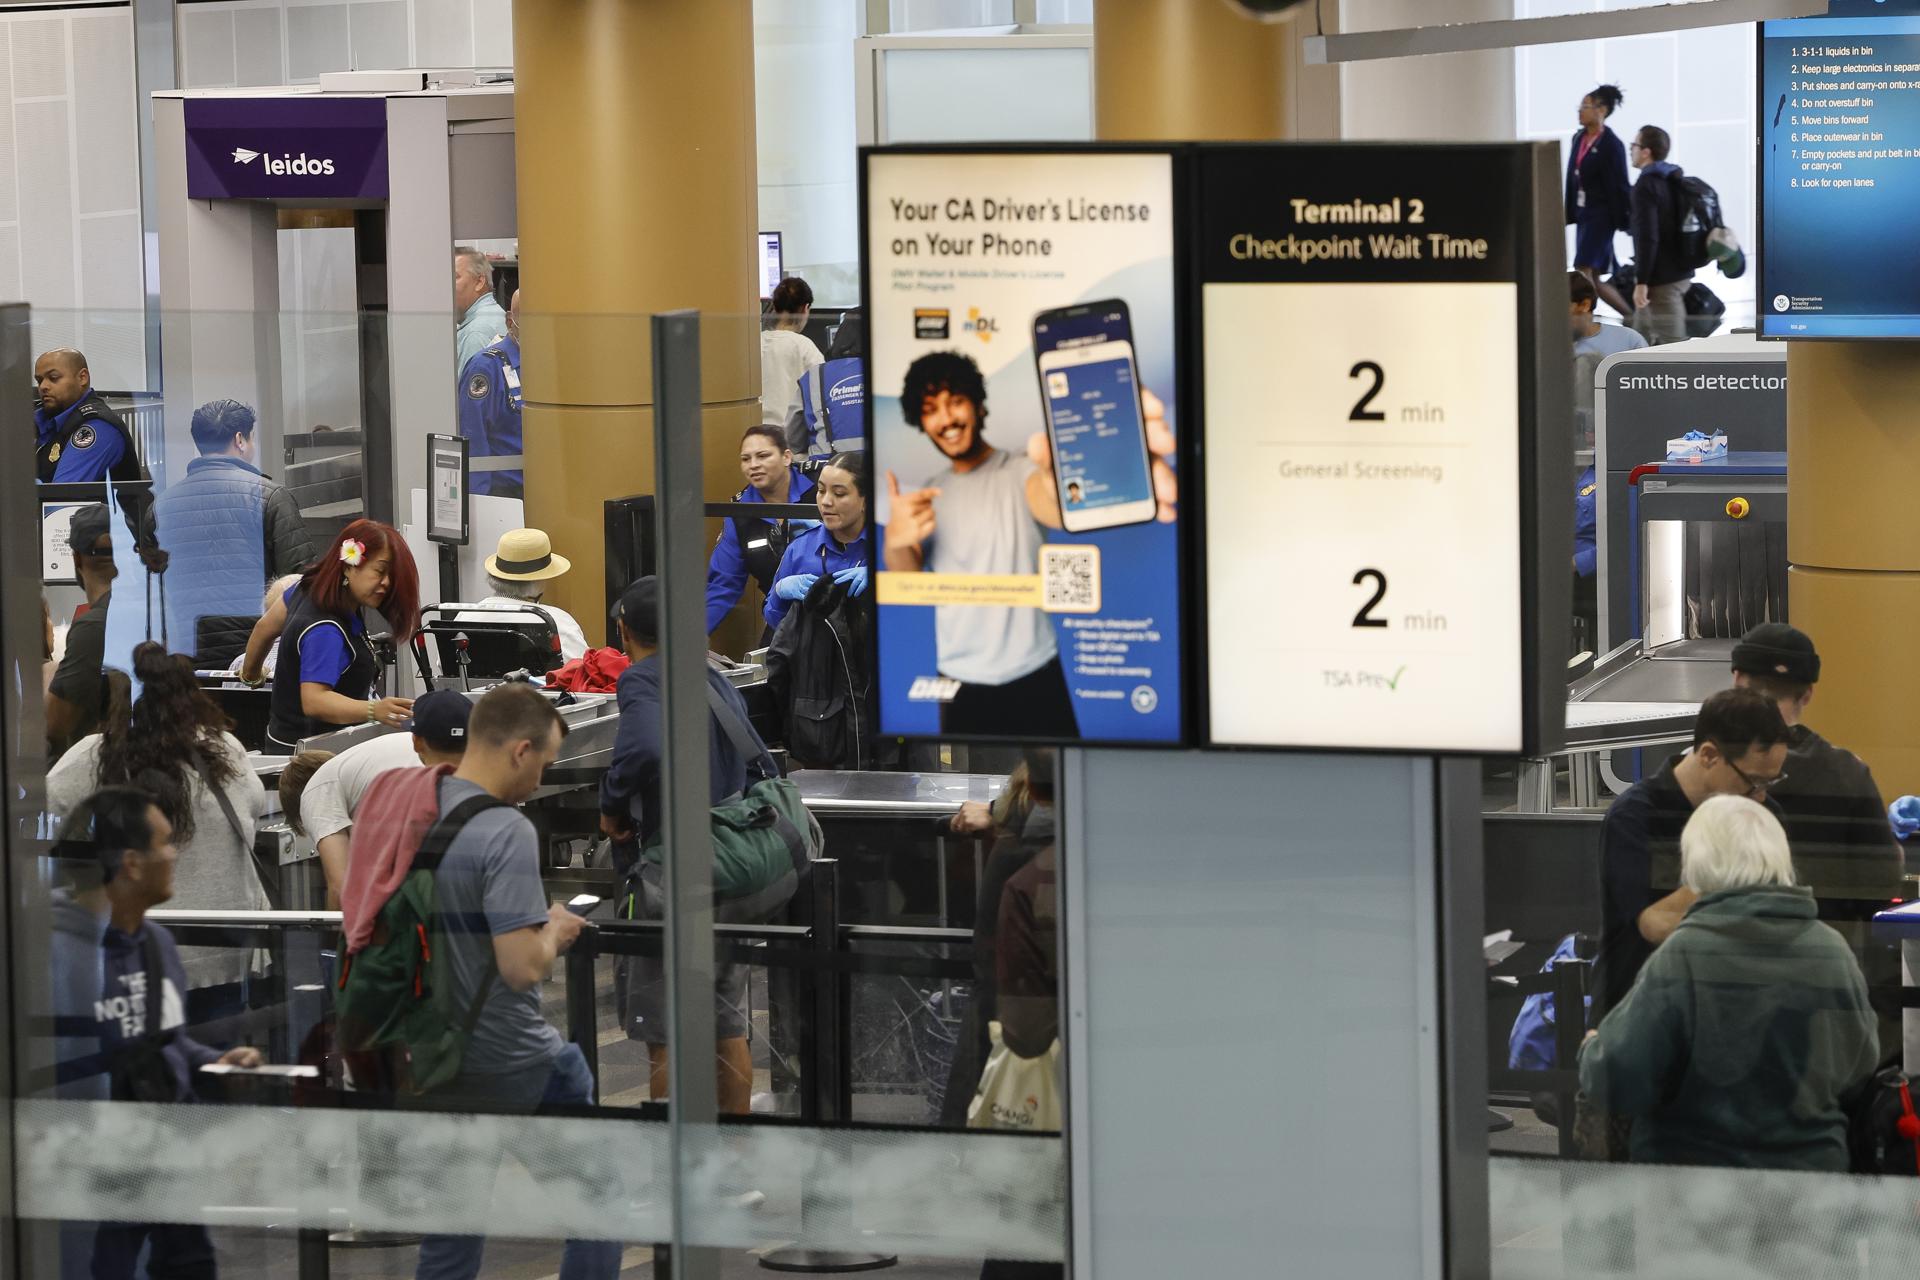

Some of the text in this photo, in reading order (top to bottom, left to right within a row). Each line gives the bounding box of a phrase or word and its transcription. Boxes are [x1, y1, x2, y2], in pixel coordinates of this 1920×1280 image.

[1792, 46, 1872, 58] 1. 3-1-1 liquids in bin
[1792, 64, 1800, 74] 2.
[1802, 64, 1821, 75] Keep
[1823, 64, 1841, 75] large
[1843, 63, 1883, 73] electronics
[1885, 63, 1892, 72] in
[1792, 82, 1799, 90] 3.
[1802, 82, 1814, 90] Put
[1816, 81, 1838, 90] shoes
[1840, 81, 1854, 90] and
[1856, 81, 1887, 91] carry-on
[1890, 80, 1906, 89] onto
[1792, 98, 1873, 108] 4. Do not overstuff bin
[1792, 115, 1868, 125] 5. Move bins forward
[1792, 132, 1883, 142] 6. Place outerwear in bin
[1792, 150, 1799, 159] 7.
[1802, 150, 1824, 160] Empty
[1826, 149, 1856, 159] pockets
[1858, 149, 1872, 158] and
[1874, 150, 1887, 159] put
[1889, 148, 1903, 158] belt
[1905, 148, 1912, 157] in
[263, 152, 335, 175] leidos
[1802, 162, 1842, 171] or carry-on
[1791, 178, 1874, 188] 8. Look for open lanes
[889, 197, 1150, 222] Your CA Driver's License
[1290, 197, 1425, 224] Terminal 2
[891, 233, 1052, 257] on Your Phone
[1229, 233, 1488, 264] Checkpoint Wait Time
[1619, 374, 1688, 389] smiths
[1348, 361, 1445, 423] 2 min
[1279, 460, 1443, 483] General Screening
[1352, 568, 1447, 631] 2 min
[1322, 670, 1353, 687] TSA
